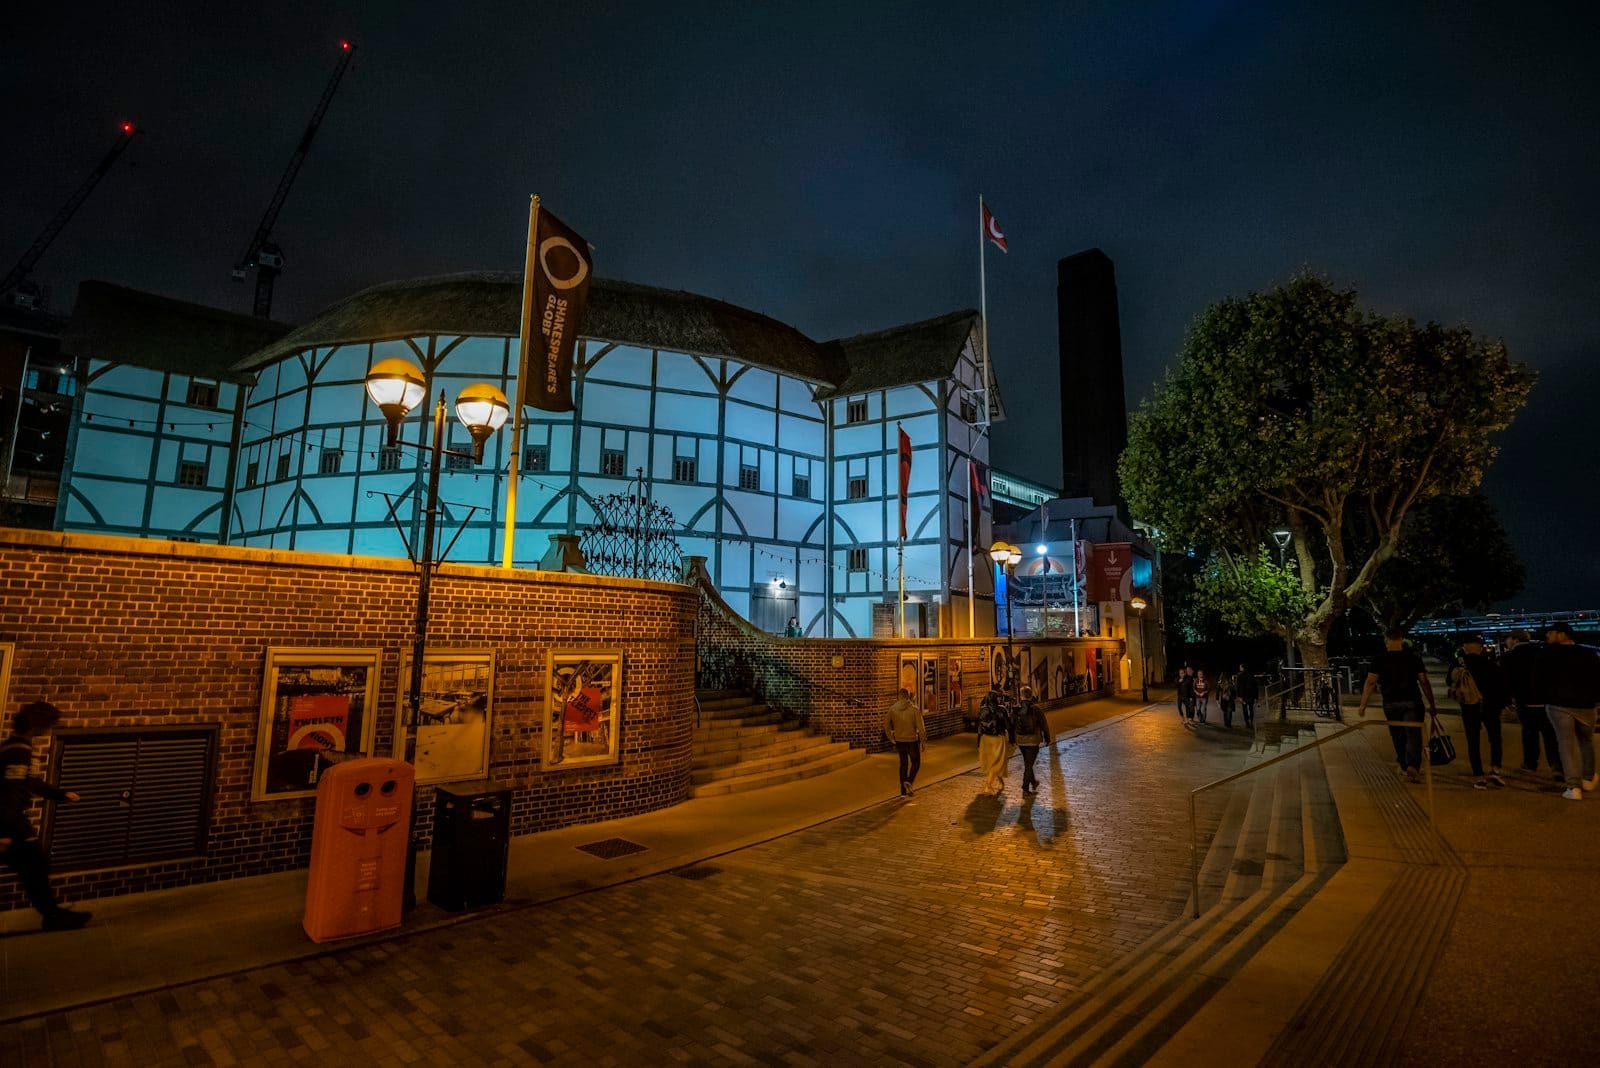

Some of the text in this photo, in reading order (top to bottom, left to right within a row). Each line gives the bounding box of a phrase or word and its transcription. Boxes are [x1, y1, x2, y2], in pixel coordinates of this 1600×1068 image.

[542, 294, 557, 337] GLOBE
[547, 298, 568, 394] SHAKESPEARE'S
[294, 716, 344, 727] TWELFTH
[309, 731, 336, 749] NIGHT
